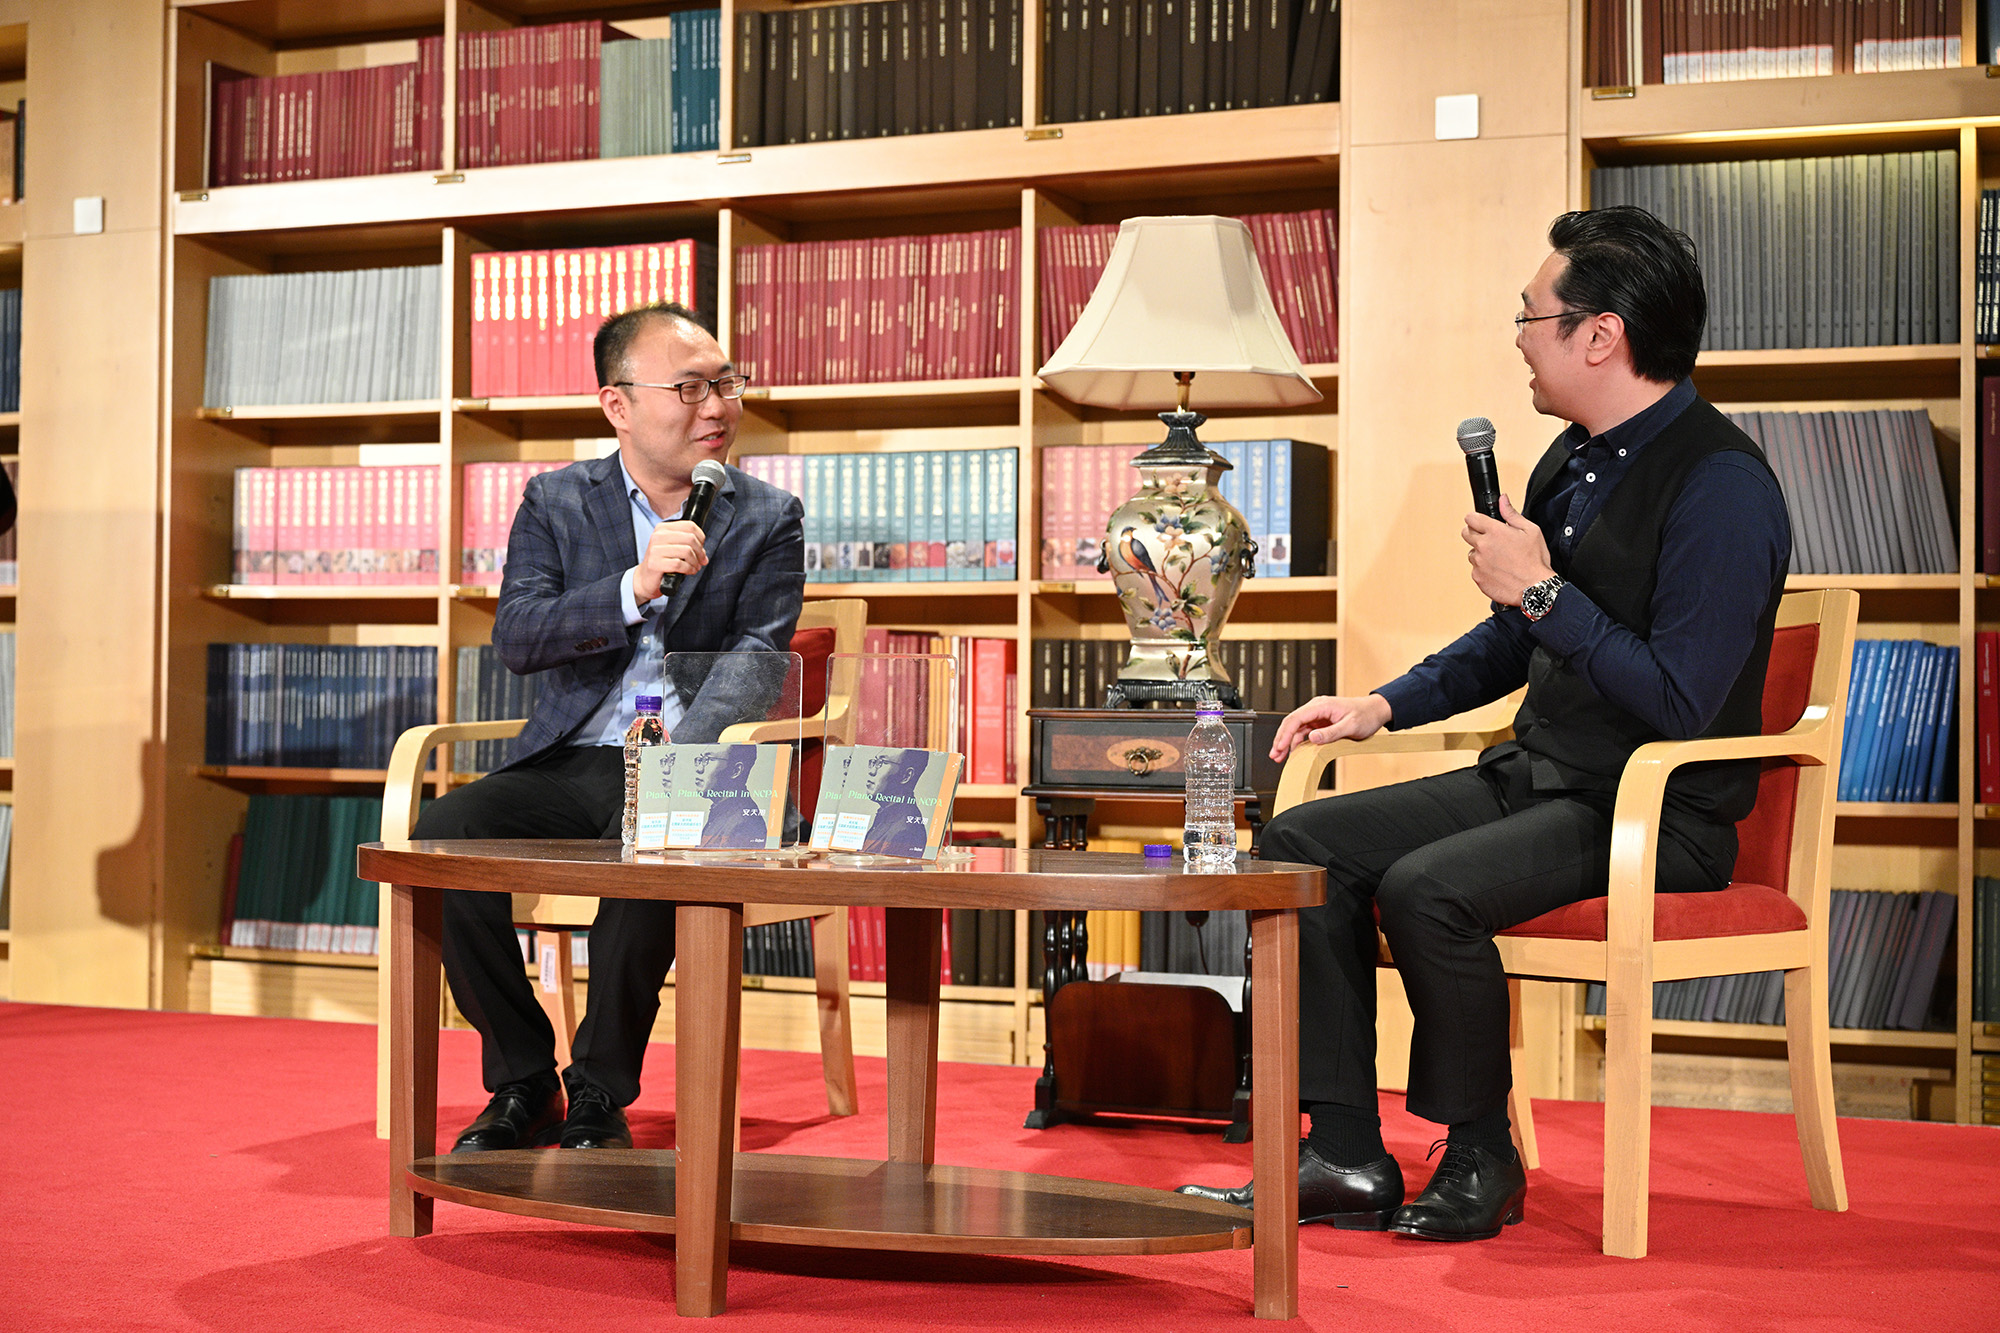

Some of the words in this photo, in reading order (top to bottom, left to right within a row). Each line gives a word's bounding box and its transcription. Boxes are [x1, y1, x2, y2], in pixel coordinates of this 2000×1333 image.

[678, 789, 704, 798] Piano
[706, 789, 738, 798] Recital
[740, 789, 750, 798] in
[752, 789, 778, 799] NCPA
[848, 790, 873, 801] Piano
[875, 792, 905, 804] Recital
[917, 797, 943, 807] NCPA
